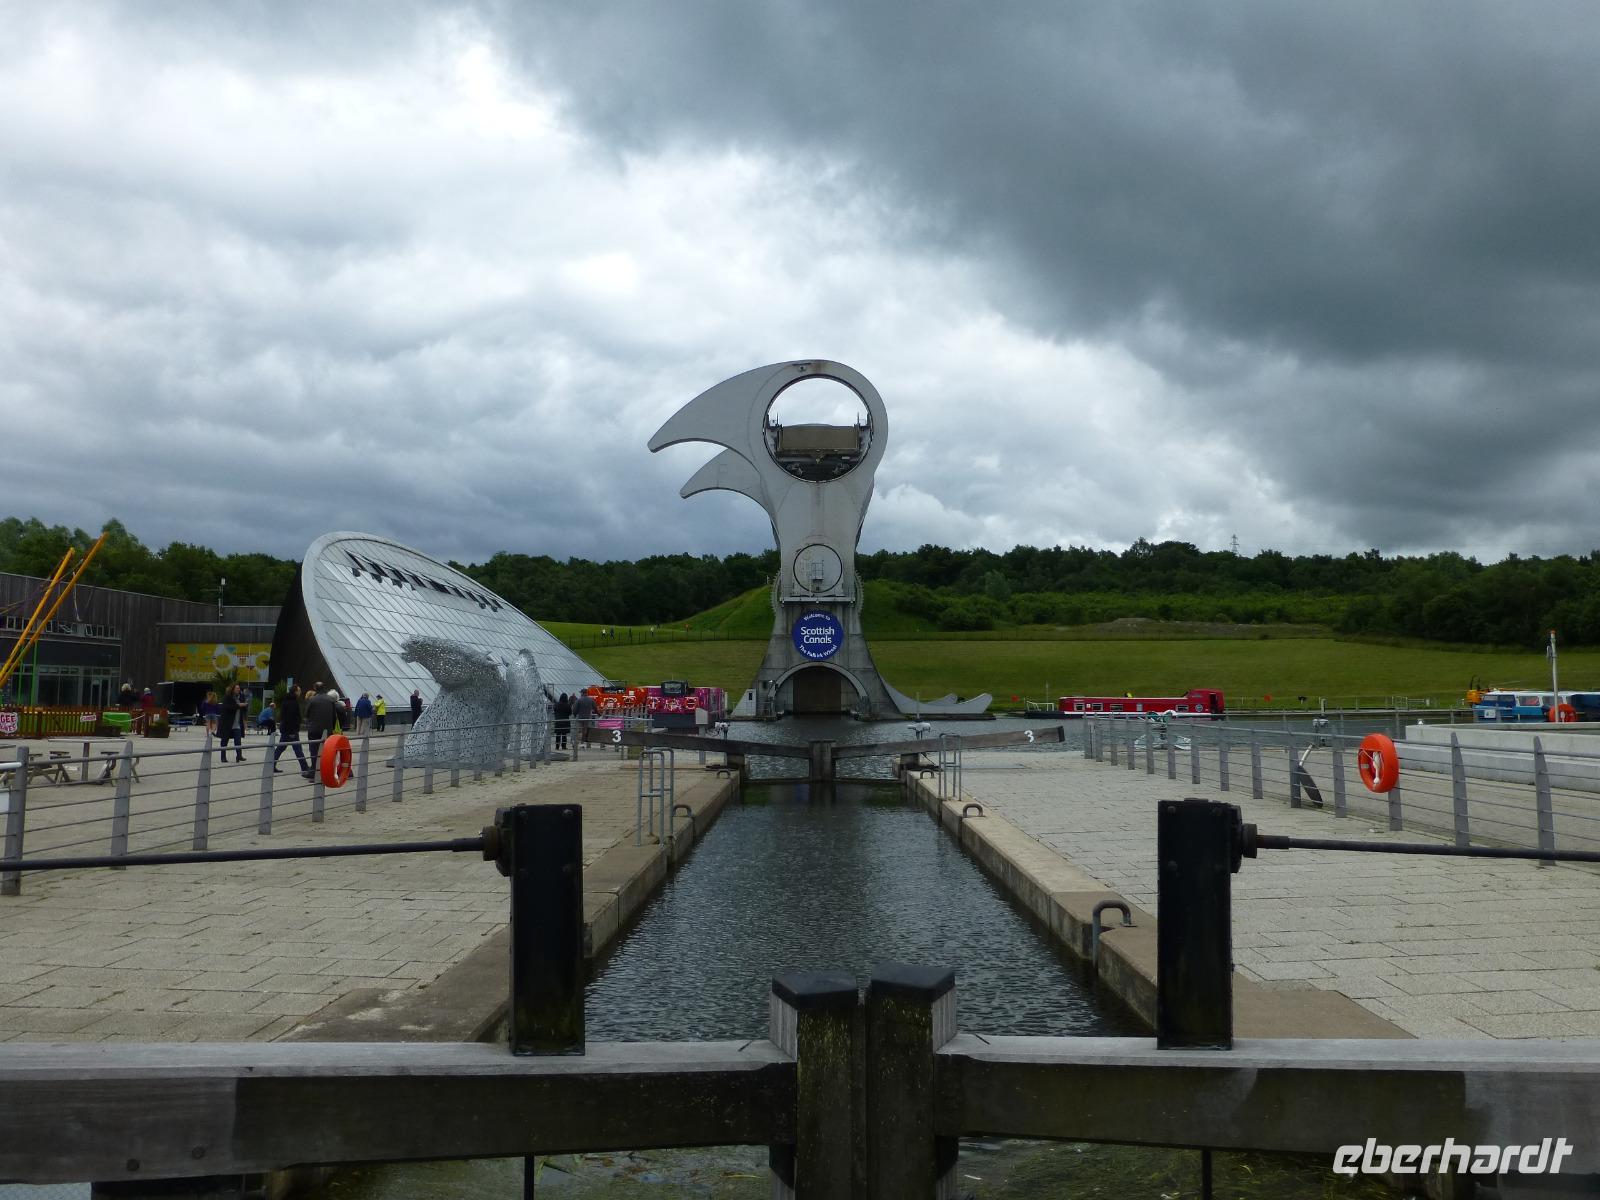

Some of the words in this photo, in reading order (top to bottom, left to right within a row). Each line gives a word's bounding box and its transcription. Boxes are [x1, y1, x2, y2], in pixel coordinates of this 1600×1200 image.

[800, 626, 835, 636] Scottish
[803, 635, 833, 644] Canals
[612, 729, 622, 743] 3
[1024, 729, 1035, 743] 3
